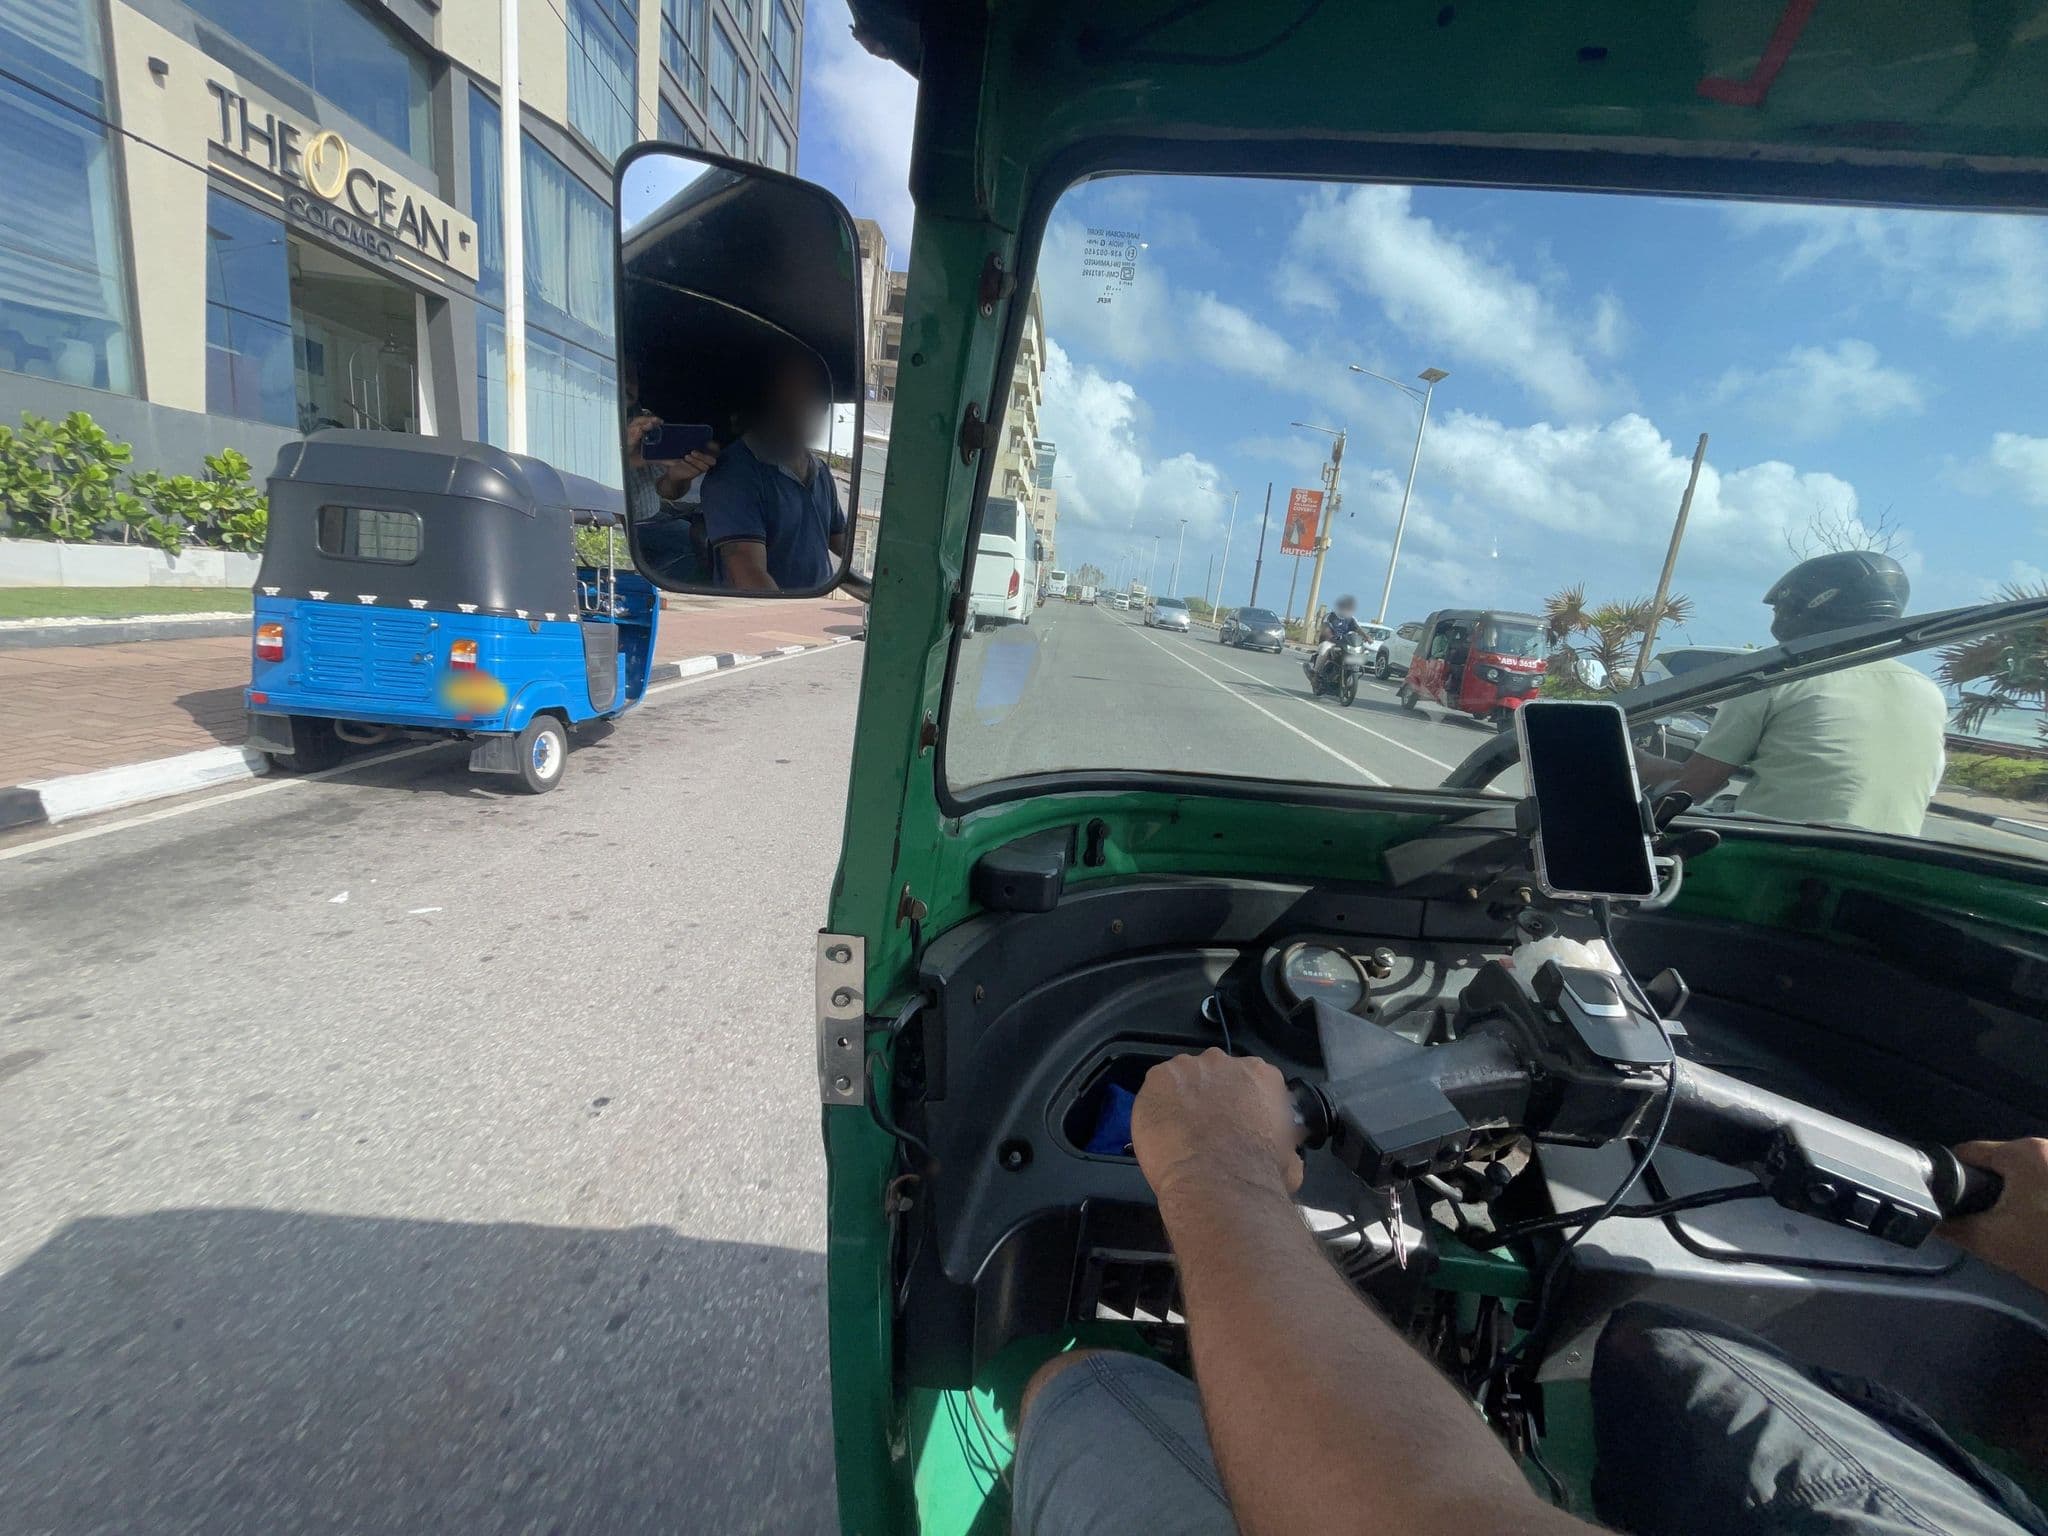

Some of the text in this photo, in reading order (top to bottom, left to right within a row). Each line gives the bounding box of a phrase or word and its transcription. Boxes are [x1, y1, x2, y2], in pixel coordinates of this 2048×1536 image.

[206, 79, 450, 262] THE OCEAN
[289, 193, 392, 262] COLOMBO
[1282, 547, 1313, 557] HUTCH
